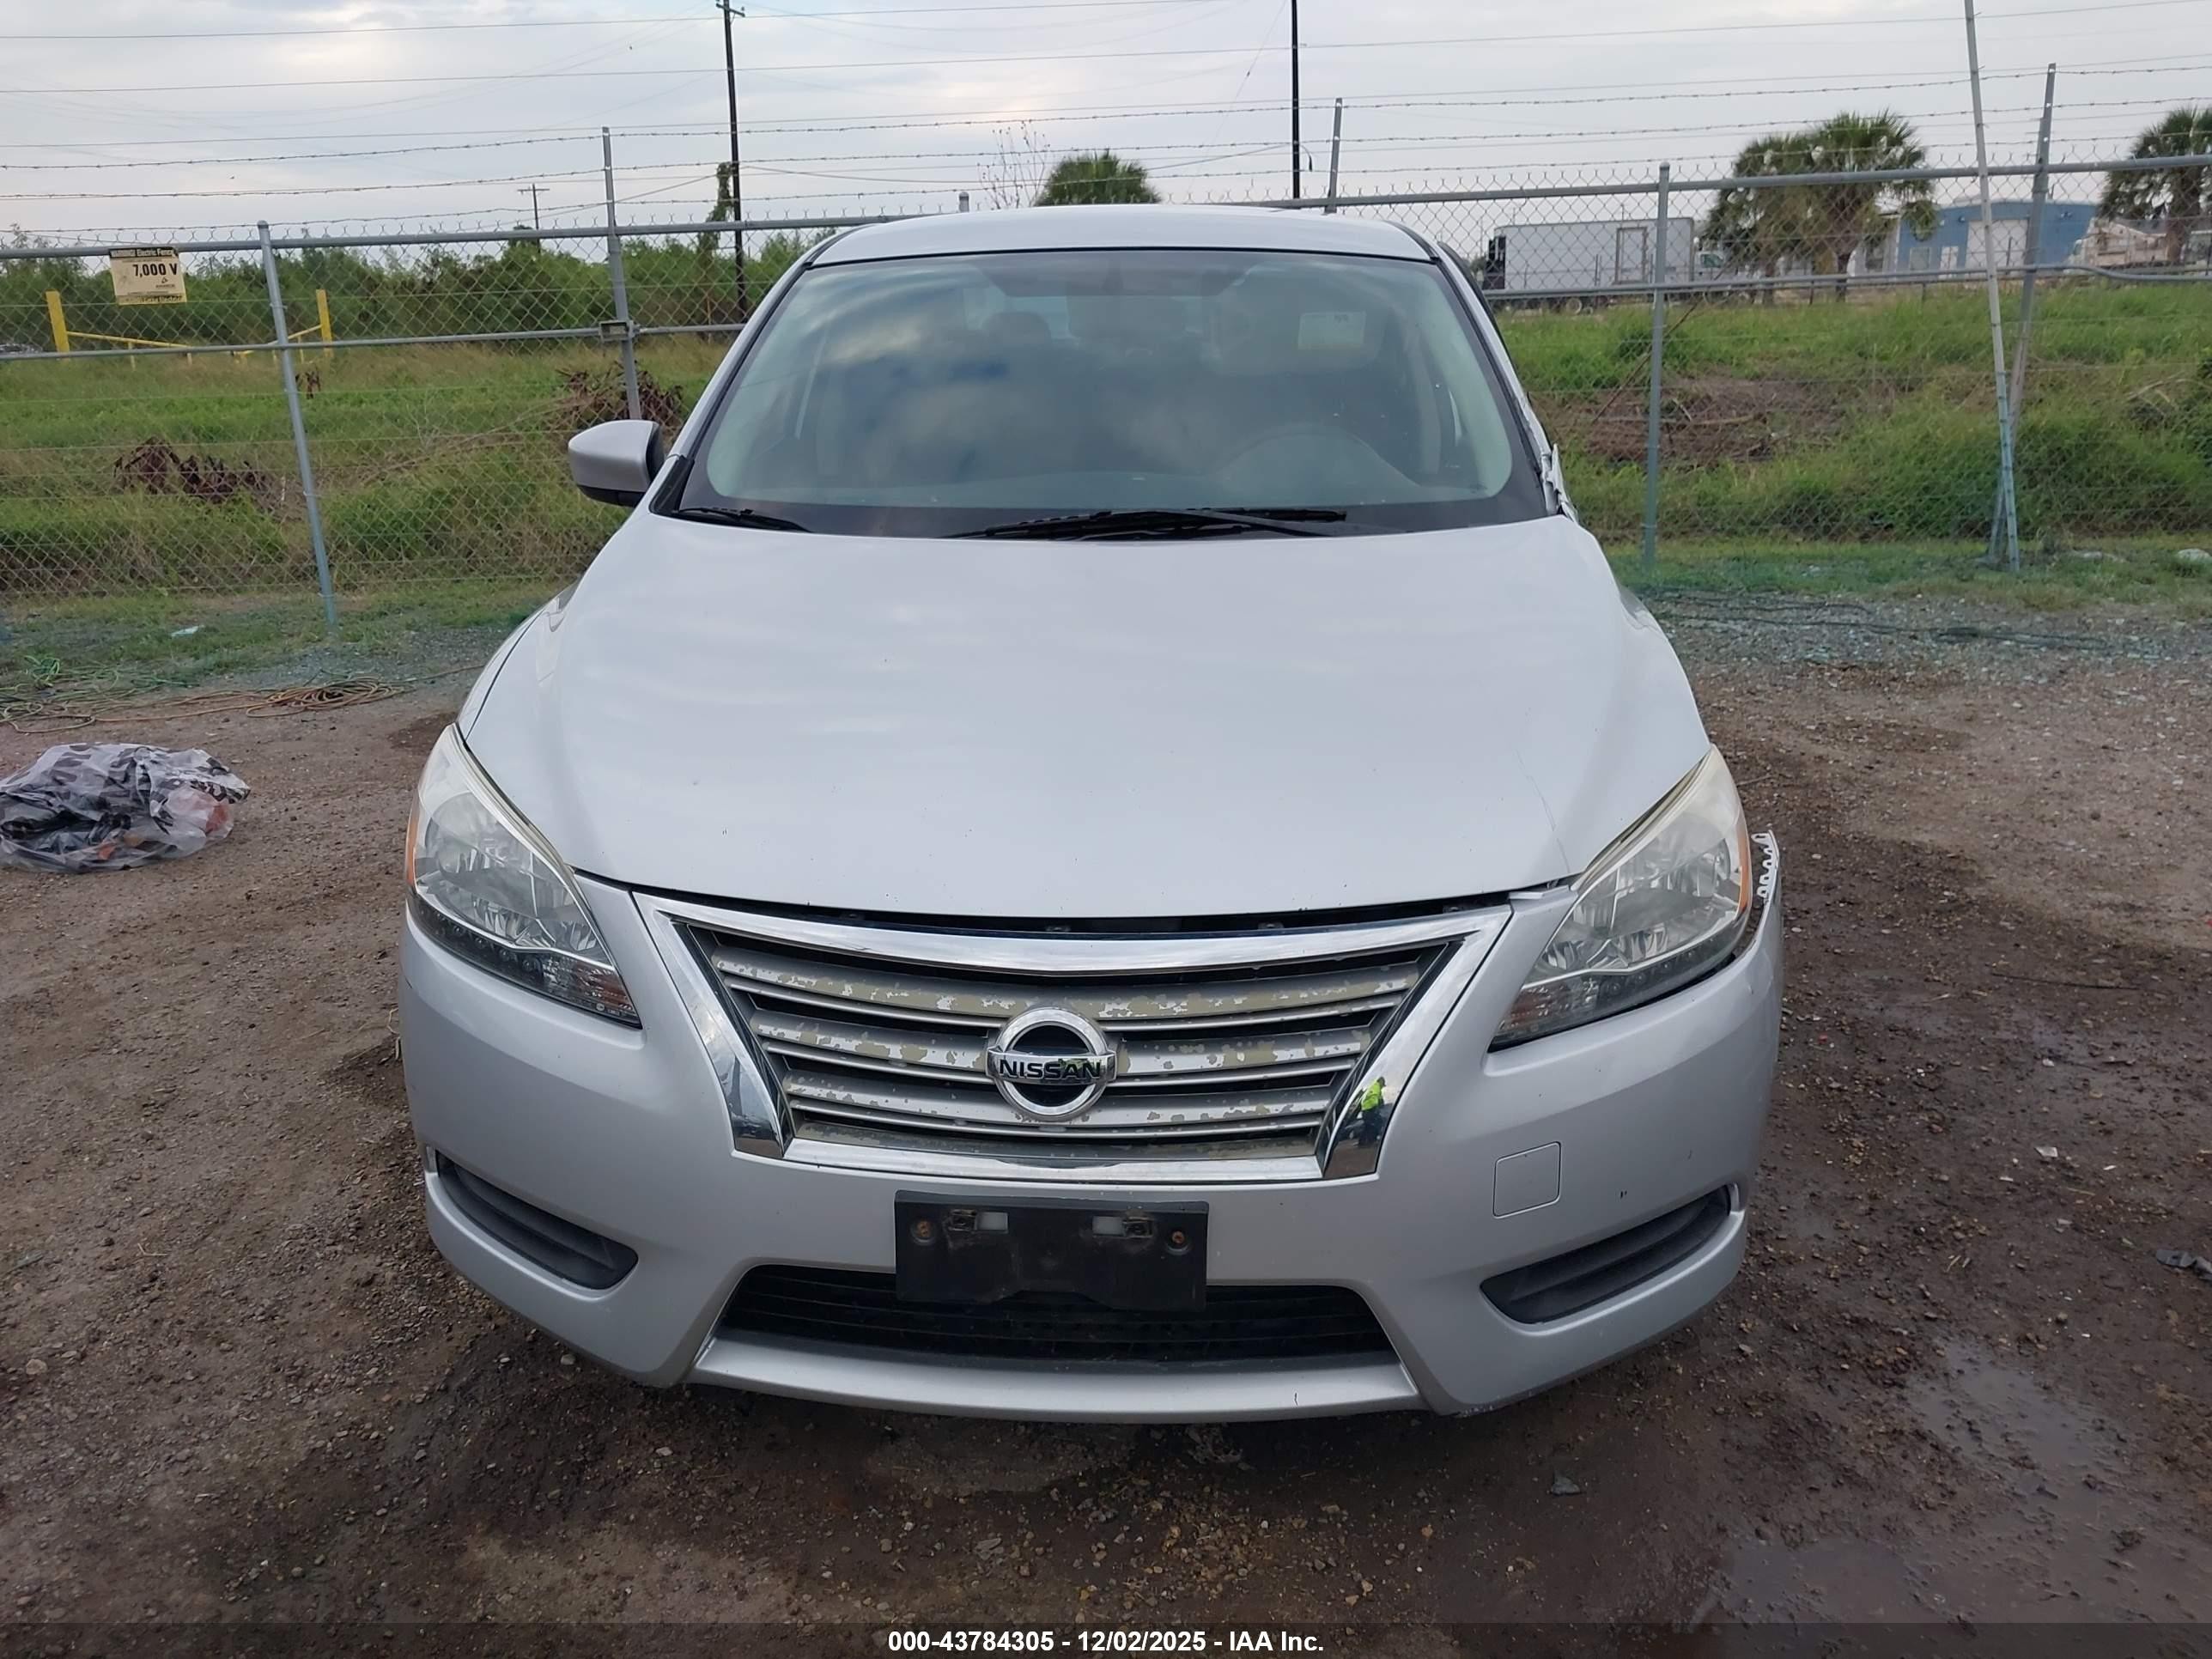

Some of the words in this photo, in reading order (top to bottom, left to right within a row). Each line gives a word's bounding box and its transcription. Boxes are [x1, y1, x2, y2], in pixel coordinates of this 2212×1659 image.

[132, 263, 167, 278] 7,000
[169, 263, 177, 275] V
[999, 1058, 1101, 1079] NISSAN
